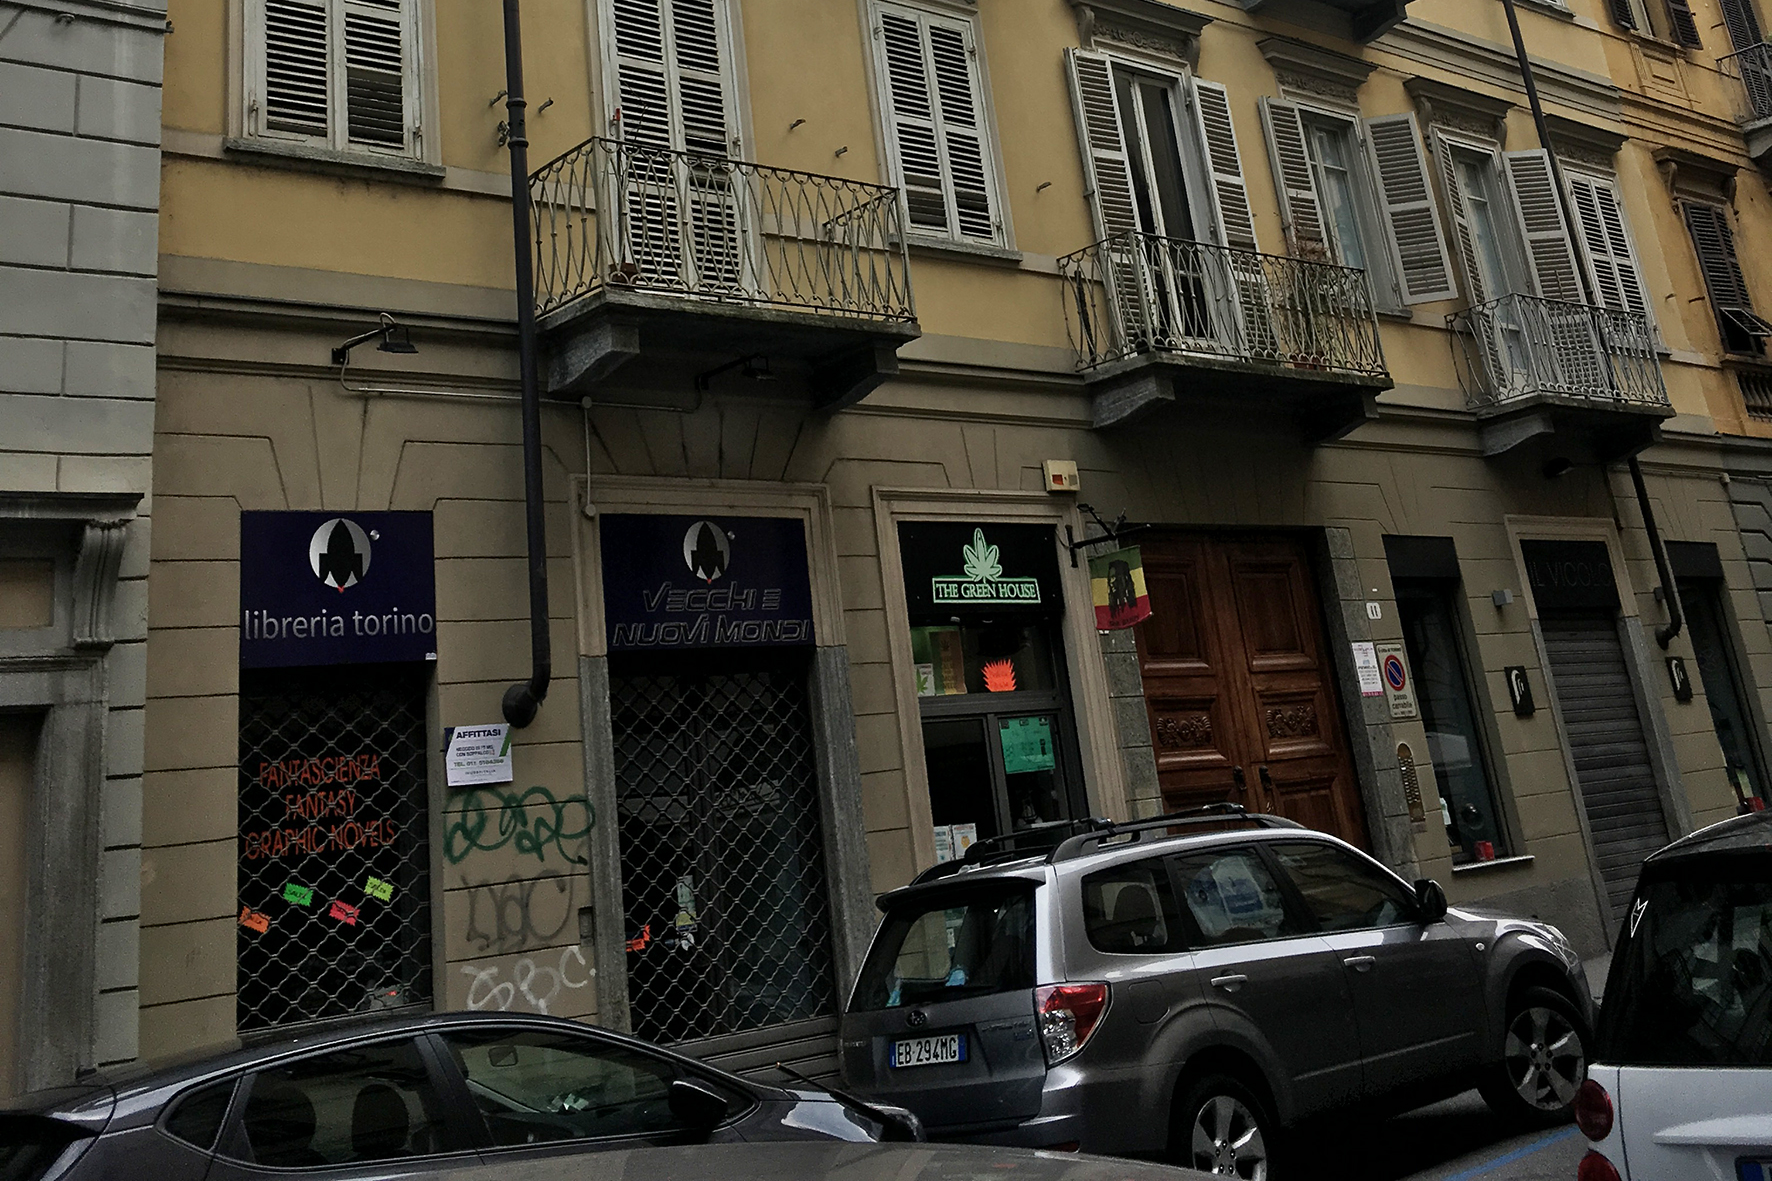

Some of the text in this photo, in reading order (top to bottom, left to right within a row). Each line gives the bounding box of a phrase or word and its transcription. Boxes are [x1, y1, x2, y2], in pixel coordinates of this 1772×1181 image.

[642, 581, 757, 612] VECCHI
[936, 583, 1037, 598] THE GREEN HOUSE
[244, 607, 434, 640] libreria torino
[612, 613, 810, 646] NUOVI MONDI
[456, 729, 502, 739] AFFITTASI
[259, 754, 381, 788] FANTASCIENZA
[285, 789, 356, 820] FANTASY
[245, 819, 395, 860] GRAPHIC NOVELS
